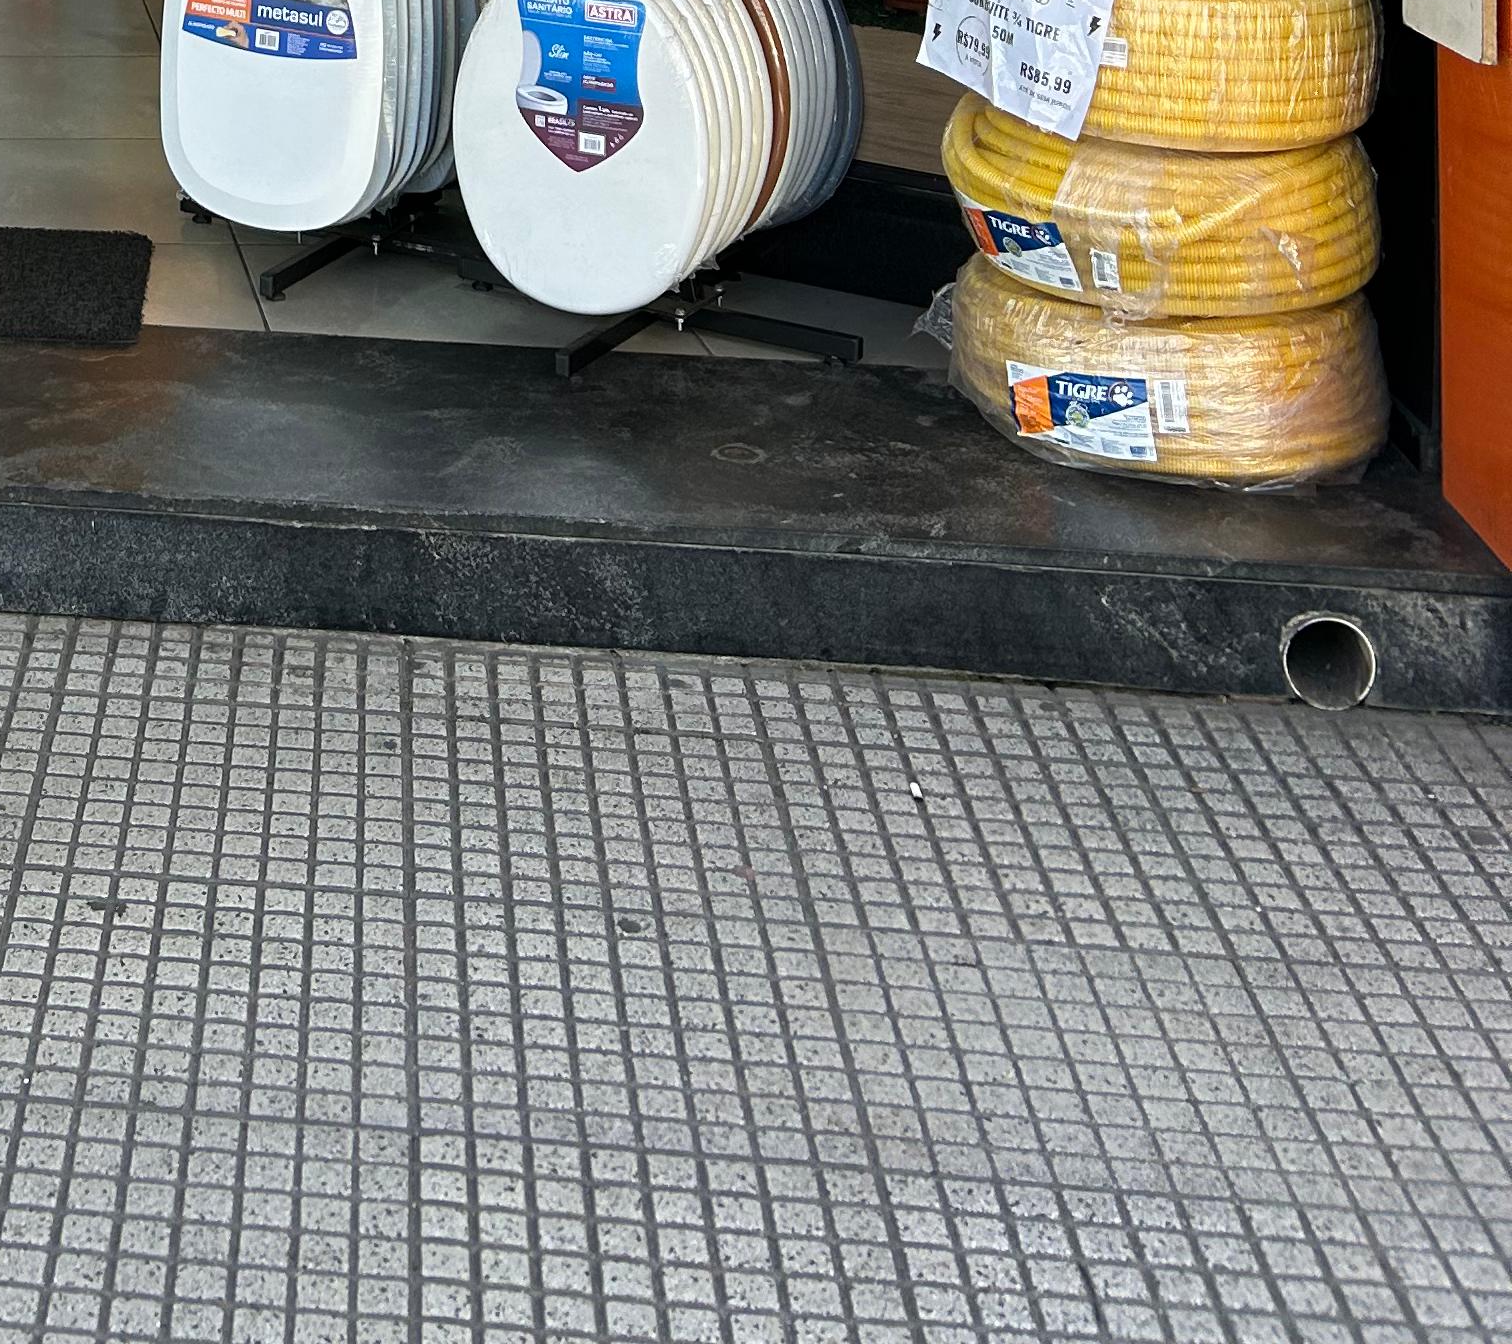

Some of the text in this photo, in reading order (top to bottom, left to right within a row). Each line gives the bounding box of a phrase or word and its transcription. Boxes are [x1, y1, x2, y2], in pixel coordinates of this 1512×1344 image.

[191, 0, 226, 16] PERFECTO
[257, 4, 323, 28] metasul
[589, 4, 634, 22] ASTRA
[991, 25, 1015, 47] 50M
[1025, 15, 1060, 42] TIGRE
[956, 28, 991, 61] R$79,99
[1019, 62, 1072, 95] R$85,99
[989, 215, 1032, 240] TIGRE
[1055, 379, 1110, 402] TIGRE
